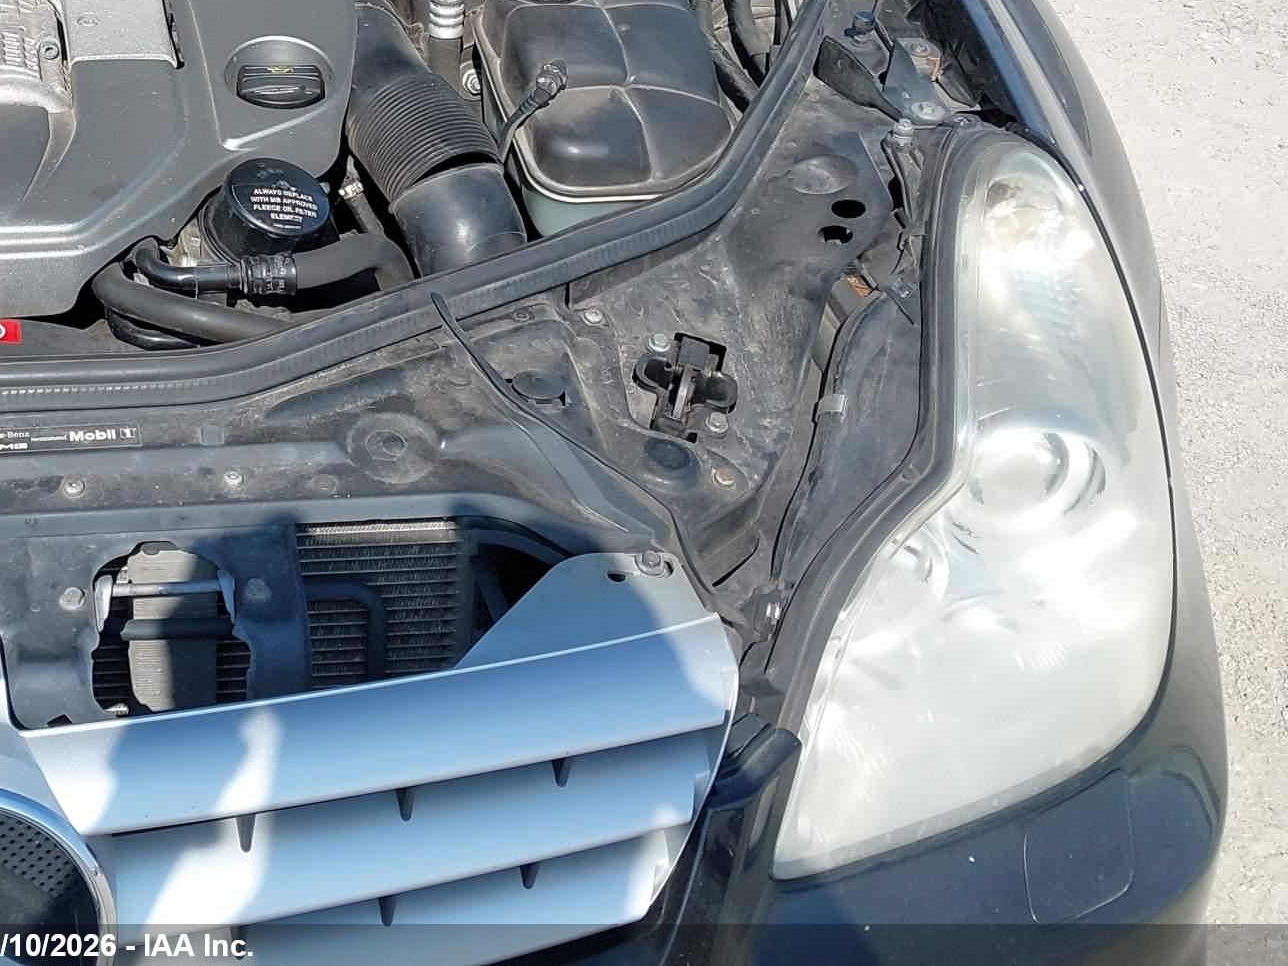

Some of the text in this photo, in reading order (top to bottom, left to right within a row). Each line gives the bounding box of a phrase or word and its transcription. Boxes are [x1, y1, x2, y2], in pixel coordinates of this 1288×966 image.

[253, 188, 313, 202] ALWAYS REPLACE
[269, 196, 281, 204] MB
[282, 198, 318, 211] APPROVED
[253, 204, 281, 212] FLEECE
[295, 207, 317, 219] FILTER
[69, 429, 116, 442] Mobil
